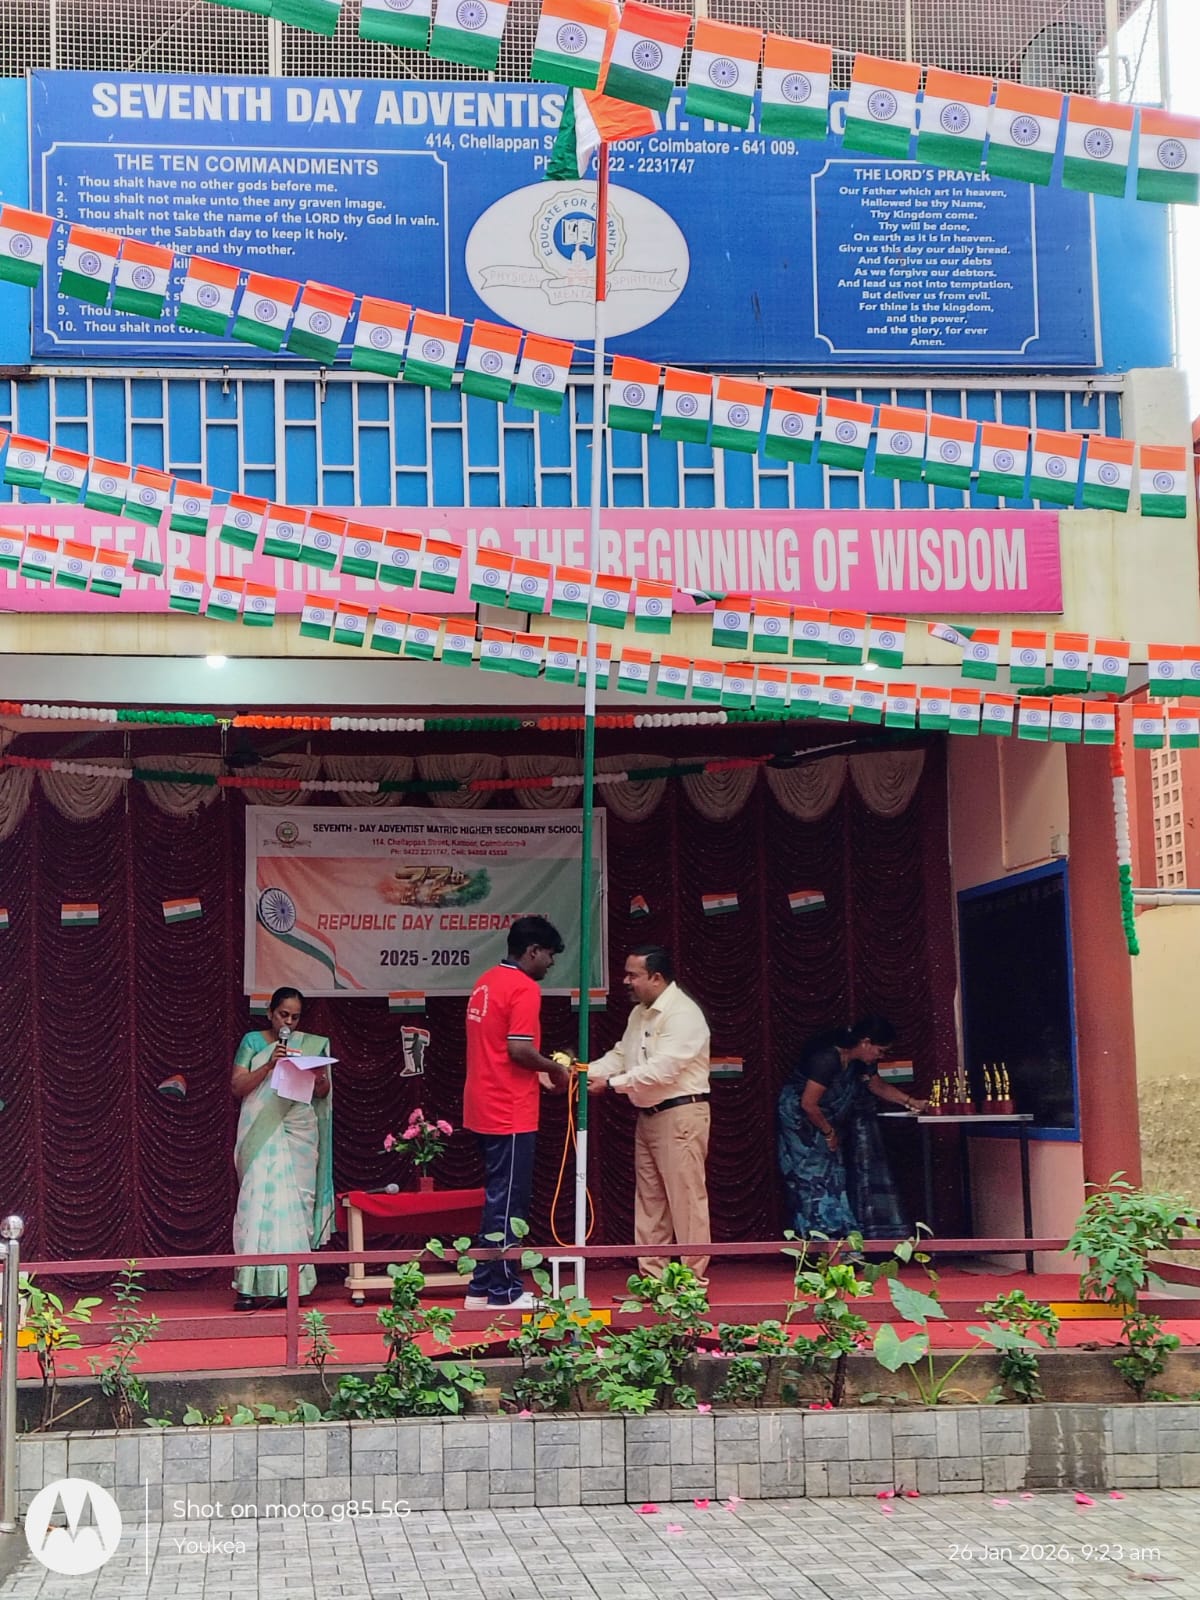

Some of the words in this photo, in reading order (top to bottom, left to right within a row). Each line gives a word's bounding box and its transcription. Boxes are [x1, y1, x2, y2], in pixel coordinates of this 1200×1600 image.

[92, 82, 271, 121] SEVENTH
[287, 88, 362, 124] DAY
[374, 90, 566, 128] ADVENTIS
[426, 135, 454, 150] 414,
[460, 134, 536, 152] Chellappan
[649, 138, 729, 153] Coimbatore
[743, 140, 765, 154] 641
[771, 141, 798, 155] 009.
[115, 154, 154, 170] THE
[160, 155, 198, 171] TEN
[206, 157, 378, 174] COMMANDMENTS
[592, 157, 624, 172] 022
[639, 158, 694, 173] 2231747
[854, 169, 881, 180] THE
[886, 170, 934, 180] LORD'S
[939, 170, 990, 181] PRAYER
[78, 176, 110, 187] Thou
[114, 177, 144, 188] shalt
[148, 177, 177, 188] have
[201, 179, 234, 189] other
[238, 180, 267, 192] gods
[272, 180, 311, 191] before
[966, 189, 1007, 197] heaven,
[78, 192, 110, 203] Thou
[115, 193, 144, 204] shalt
[148, 195, 169, 204] not
[173, 195, 206, 205] make
[211, 197, 239, 206] unto
[243, 196, 270, 206] thee
[274, 199, 295, 209] any
[300, 200, 341, 210] graven
[346, 198, 385, 211] image.
[862, 199, 911, 208] Hallowed
[915, 199, 928, 208] be
[932, 200, 949, 209] thy
[952, 200, 986, 208] Name,
[57, 208, 68, 219] 3.
[79, 208, 110, 219] Thou
[115, 209, 144, 220] shalt
[149, 211, 169, 220] not
[173, 210, 199, 221] take
[204, 211, 223, 221] the
[266, 212, 278, 222] of
[282, 213, 301, 223] the
[306, 213, 339, 223] LORD
[344, 214, 363, 227] thy
[367, 214, 391, 224] God
[396, 215, 406, 225] in
[411, 216, 439, 225] vain.
[871, 210, 890, 221] Thy
[894, 211, 942, 222] Kingdom
[540, 205, 562, 256] EDUCATE
[564, 198, 588, 208] FOR
[879, 222, 898, 233] Thy
[924, 222, 937, 231] be
[940, 223, 969, 233] done,
[151, 226, 171, 236] the
[175, 226, 225, 237] Sabbath
[230, 228, 252, 240] day
[256, 230, 268, 238] to
[273, 228, 301, 241] keep
[306, 229, 314, 239] it
[318, 229, 347, 242] holy.
[873, 234, 901, 242] earth
[953, 235, 995, 243] heaven.
[196, 243, 219, 253] and
[223, 243, 243, 256] thy
[248, 244, 295, 255] mother.
[882, 245, 901, 254] this
[904, 245, 923, 255] day
[948, 246, 974, 256] daily
[976, 246, 1010, 254] bread.
[884, 256, 922, 268] forgive
[490, 270, 541, 284] PHYSICAL
[614, 274, 668, 286] SPIRITUAL
[890, 268, 928, 278] forgive
[953, 269, 997, 278] debtors.
[927, 280, 947, 289] into
[951, 281, 1013, 292] temptation,
[553, 289, 594, 299] MENTA
[884, 291, 921, 300] deliver
[939, 292, 965, 301] from
[969, 292, 990, 301] evil.
[59, 305, 68, 315] 9.
[80, 306, 111, 316] Thou
[881, 303, 907, 312] thine
[944, 303, 994, 313] kingdom,
[57, 320, 78, 332] 10.
[84, 321, 116, 332] Thou
[121, 322, 150, 332] shalt
[155, 324, 175, 333] not
[887, 315, 906, 323] and
[931, 317, 967, 326] power,
[912, 326, 942, 336] glory,
[600, 528, 800, 592] BEGINNING
[812, 528, 858, 592] OF
[870, 528, 1028, 592] WISDOM
[378, 825, 424, 833] ADVENTIST
[427, 825, 458, 834] MATRIC
[460, 826, 492, 834] HIGHER
[495, 826, 546, 834] SECONDARY
[318, 914, 397, 930] REPUBLIC
[402, 914, 434, 930] DAY
[440, 914, 528, 930] CELEBRA
[380, 950, 418, 966] 2025
[432, 950, 470, 966] 2026
